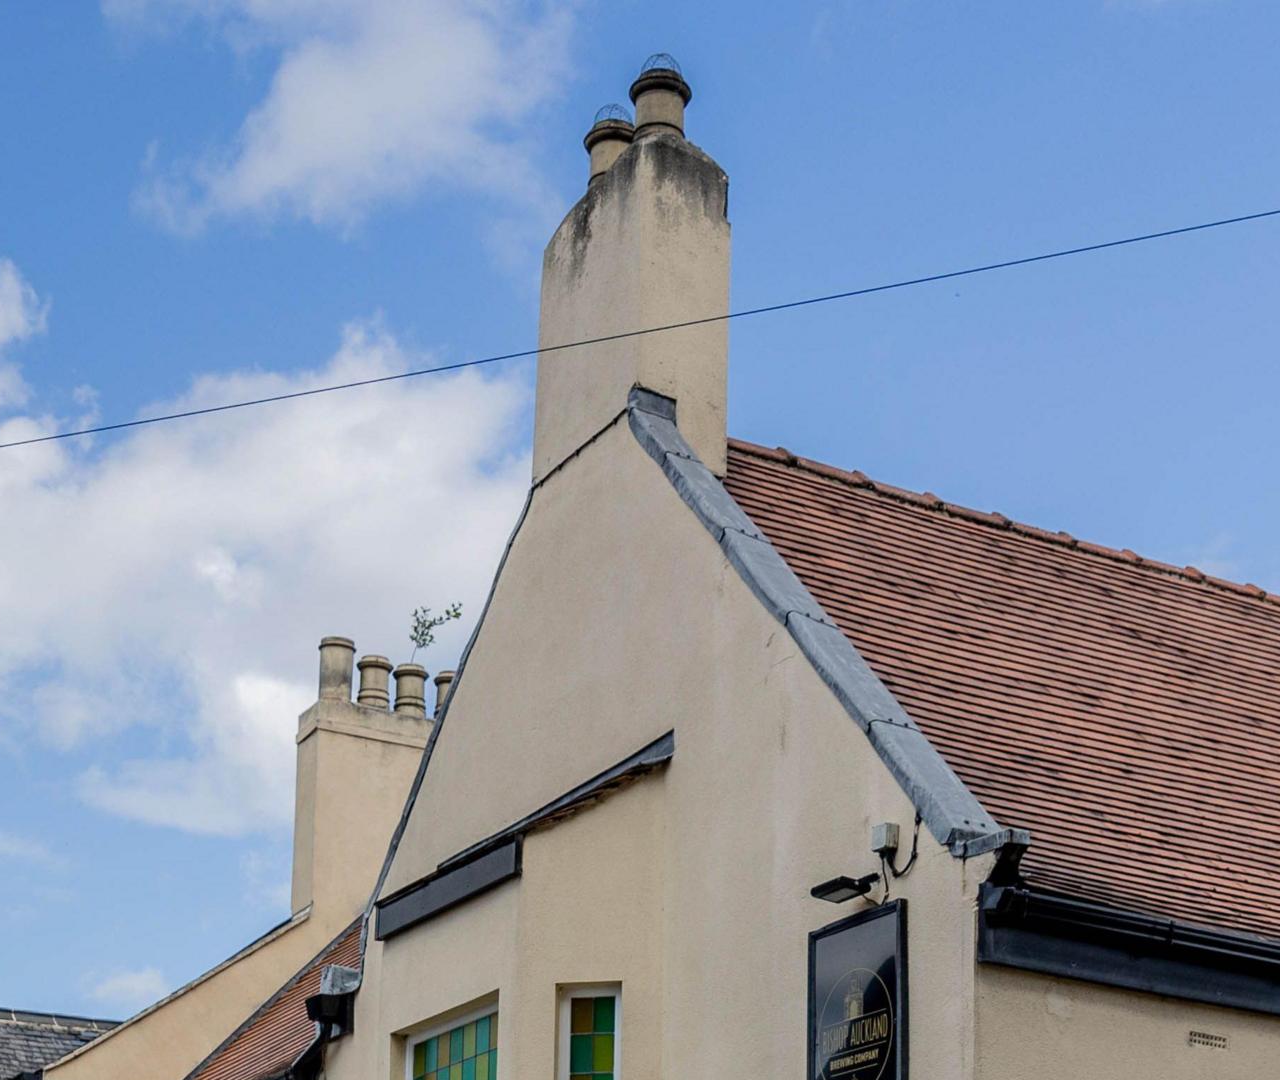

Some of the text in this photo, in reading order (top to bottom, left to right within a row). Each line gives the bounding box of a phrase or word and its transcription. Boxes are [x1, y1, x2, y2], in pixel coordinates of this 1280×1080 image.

[822, 1012, 888, 1056] BISHOP AUCKLAND
[830, 1048, 880, 1071] BREWING COMPANY
